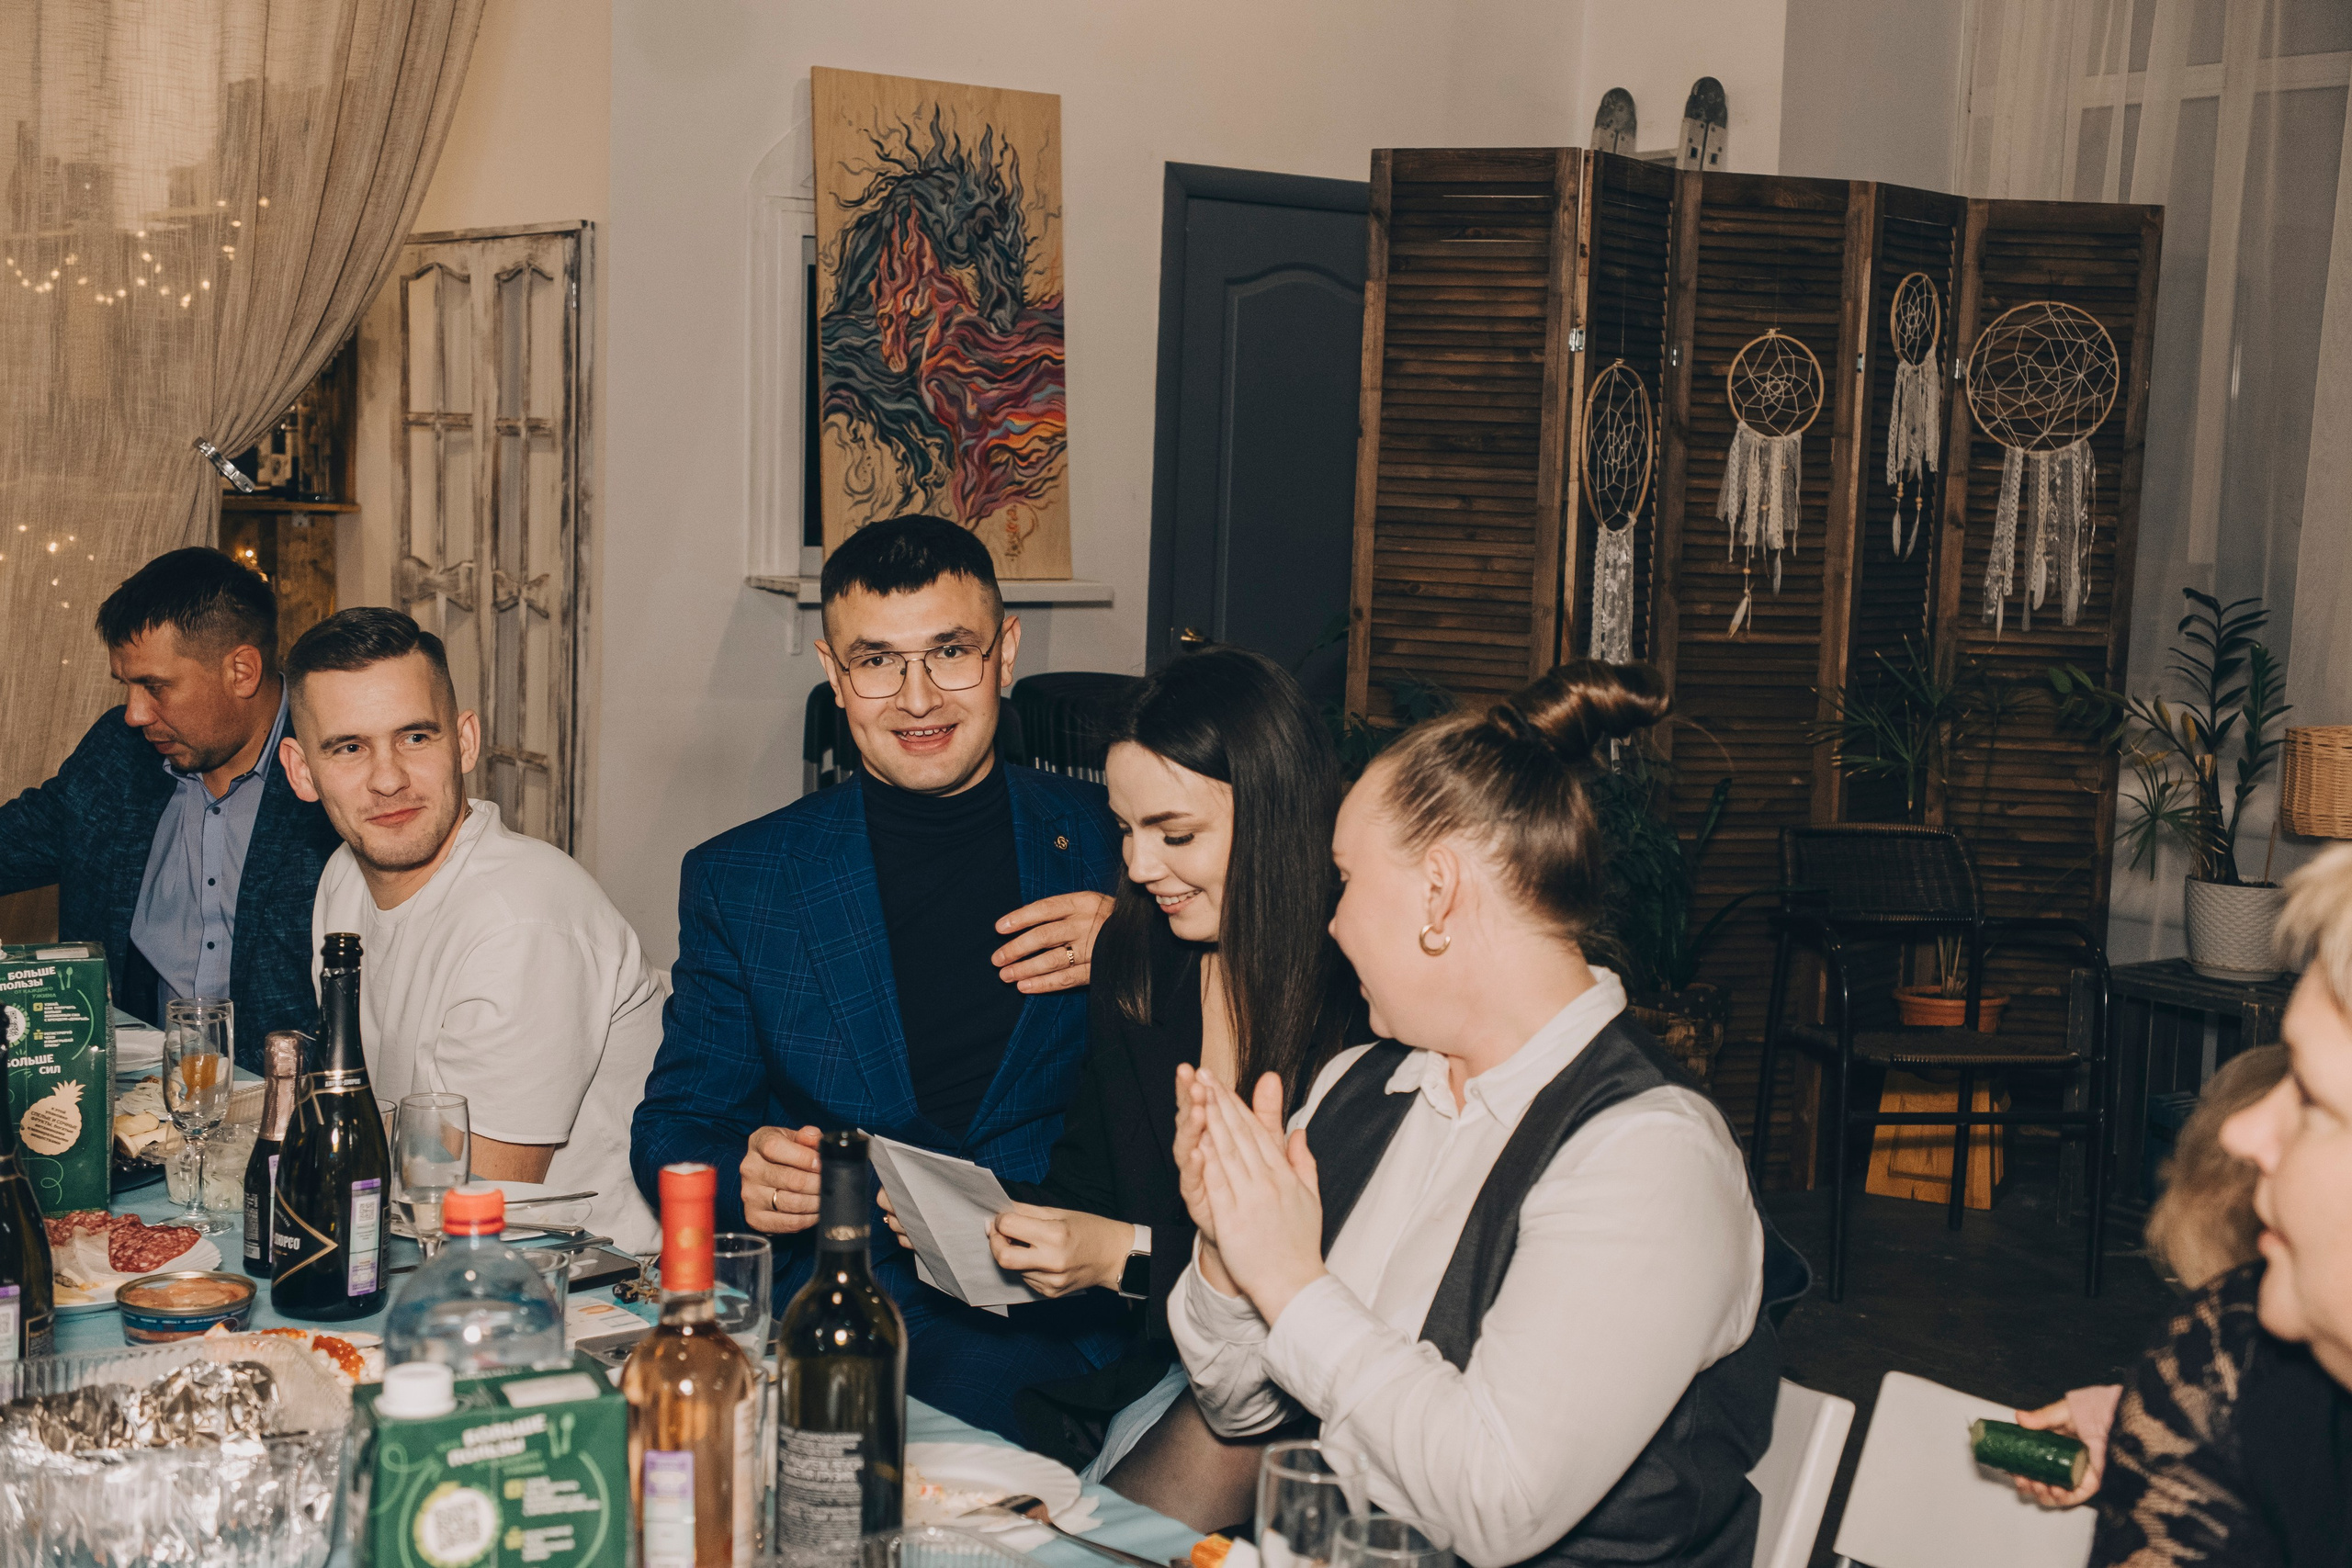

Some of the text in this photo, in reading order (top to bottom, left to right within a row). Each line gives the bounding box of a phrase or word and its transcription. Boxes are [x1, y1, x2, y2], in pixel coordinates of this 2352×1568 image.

[7, 966, 56, 980] БОЛЬШЕ
[0, 978, 43, 991] ПОЛЬЗЫ
[39, 1066, 62, 1075] СИЛ
